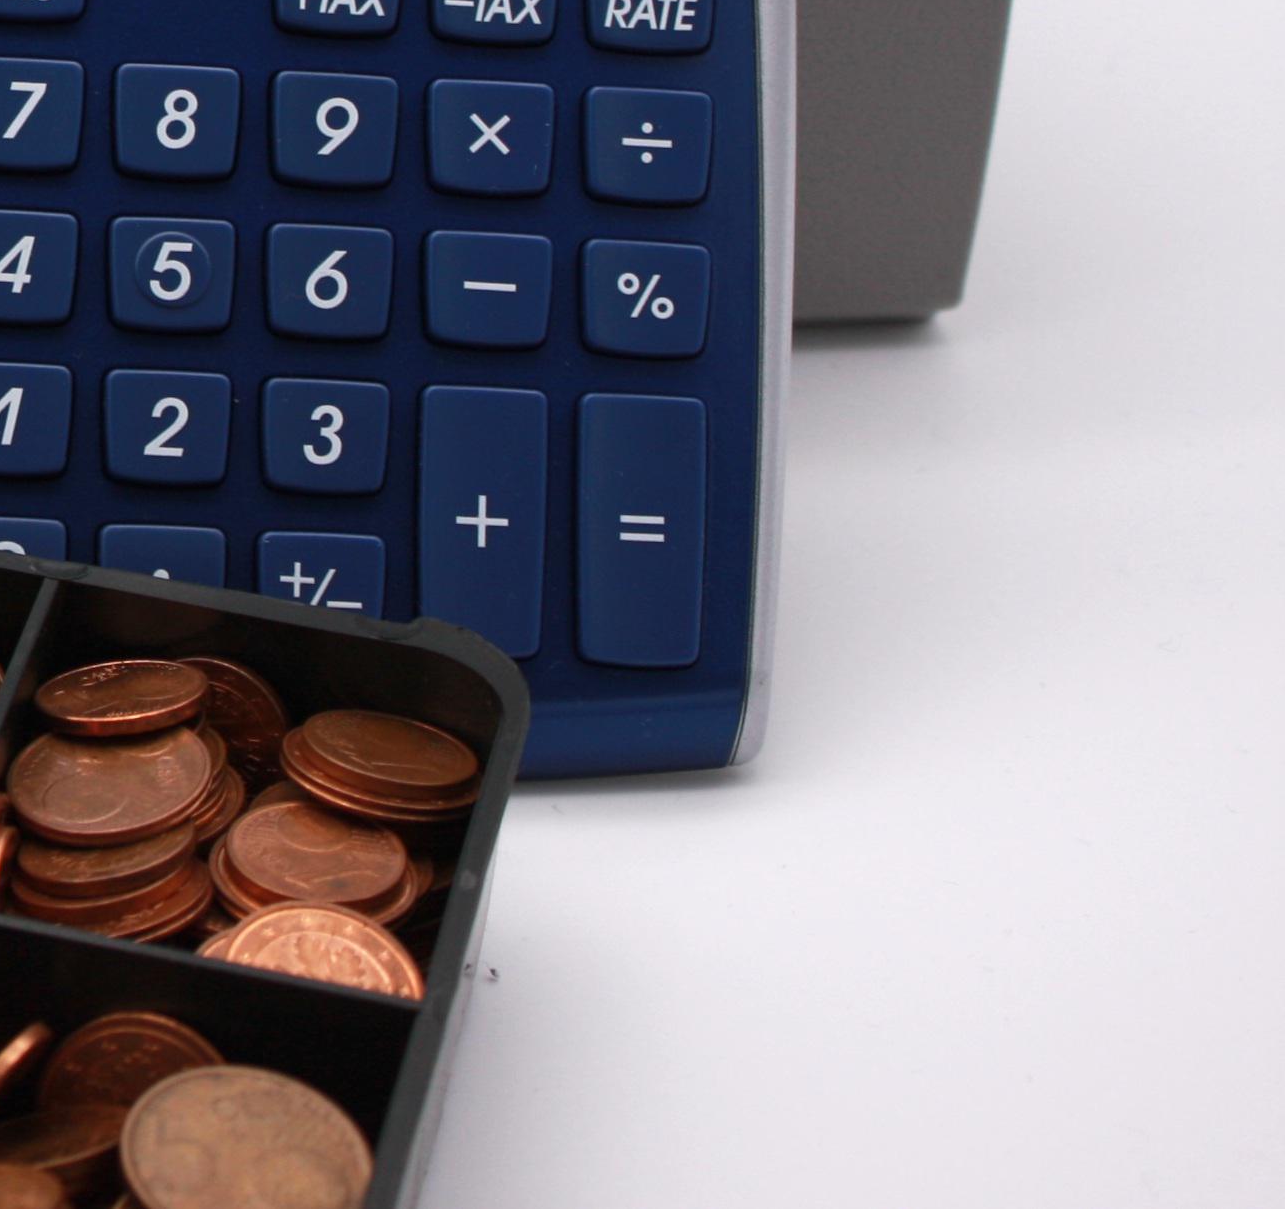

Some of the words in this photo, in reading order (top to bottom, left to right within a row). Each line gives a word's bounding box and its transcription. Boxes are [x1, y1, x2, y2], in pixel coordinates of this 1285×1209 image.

[2, 81, 48, 139] 7
[156, 88, 199, 150] 8
[315, 97, 360, 156] 9
[149, 241, 194, 301] 5
[305, 250, 349, 310] 6
[143, 396, 189, 457] 2
[303, 404, 345, 465] 3
